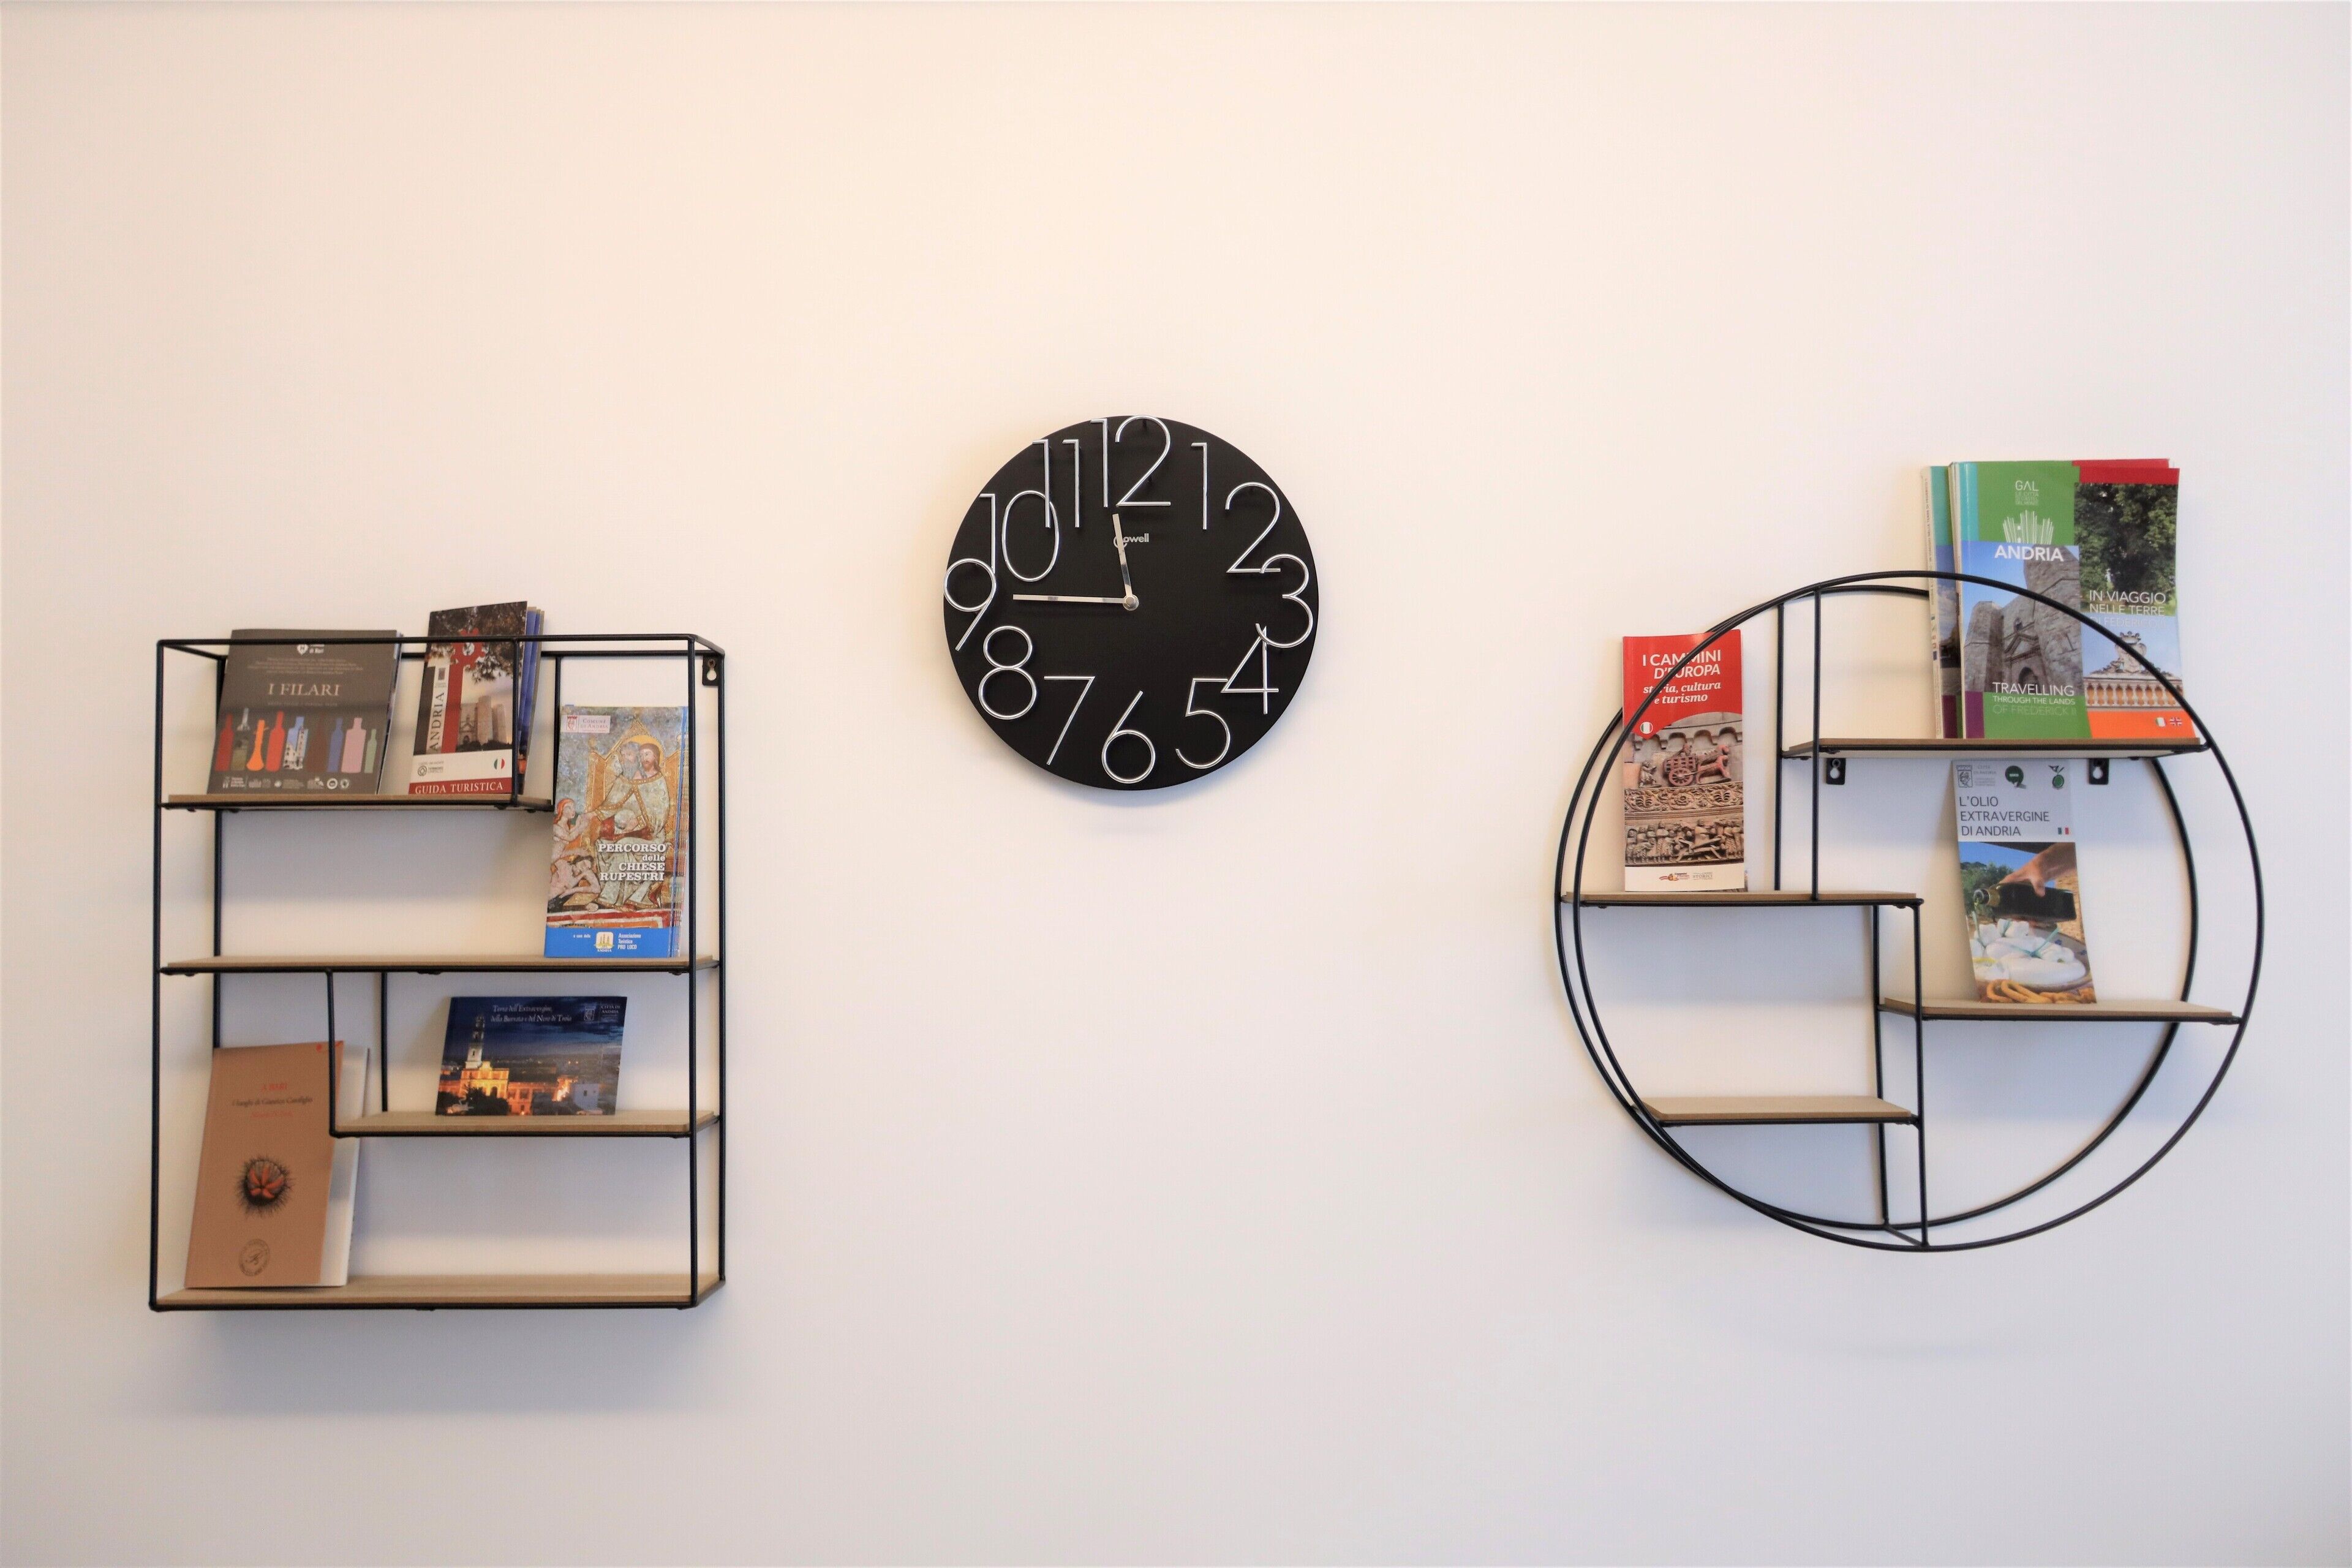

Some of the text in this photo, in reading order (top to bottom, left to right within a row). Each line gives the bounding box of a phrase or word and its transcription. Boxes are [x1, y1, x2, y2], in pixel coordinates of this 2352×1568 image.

[1090, 415, 1170, 508] 12
[1033, 439, 1079, 528] 11
[1191, 442, 1207, 530] 1
[2015, 480, 2039, 492] GAL
[1225, 482, 1281, 573] 2
[979, 490, 1060, 582] 10
[1115, 533, 1149, 547] owell
[1994, 545, 2064, 562] ANDRIA
[943, 558, 997, 651] 9
[1256, 554, 1314, 648] 3
[2089, 590, 2166, 605] IN VIAGGIO
[2089, 603, 2165, 616] NELLE TERRE
[1642, 655, 1646, 666] I
[978, 626, 1037, 720] 8
[1221, 626, 1279, 714] 4
[268, 683, 341, 696] I FILARI
[1681, 682, 1721, 692] cultura
[1992, 682, 2075, 696] TRAVELLING
[1662, 693, 1708, 704] turismo
[1993, 704, 2008, 714] OF
[2011, 705, 2070, 716] FREDERICK
[429, 692, 445, 752] ANDRIA
[1044, 676, 1095, 765] 7
[1175, 677, 1231, 769] 5
[1101, 690, 1156, 783] 6
[415, 782, 503, 794] GUIDA TURISTICA
[1959, 796, 1999, 807] L'OLIO
[1960, 811, 2050, 822] EXTRAVERGINE
[1961, 826, 2021, 836] DI ANDRIA
[598, 843, 666, 853] PERCORSO
[618, 862, 665, 871] CHIESE
[600, 872, 665, 881] RUPESTRI
